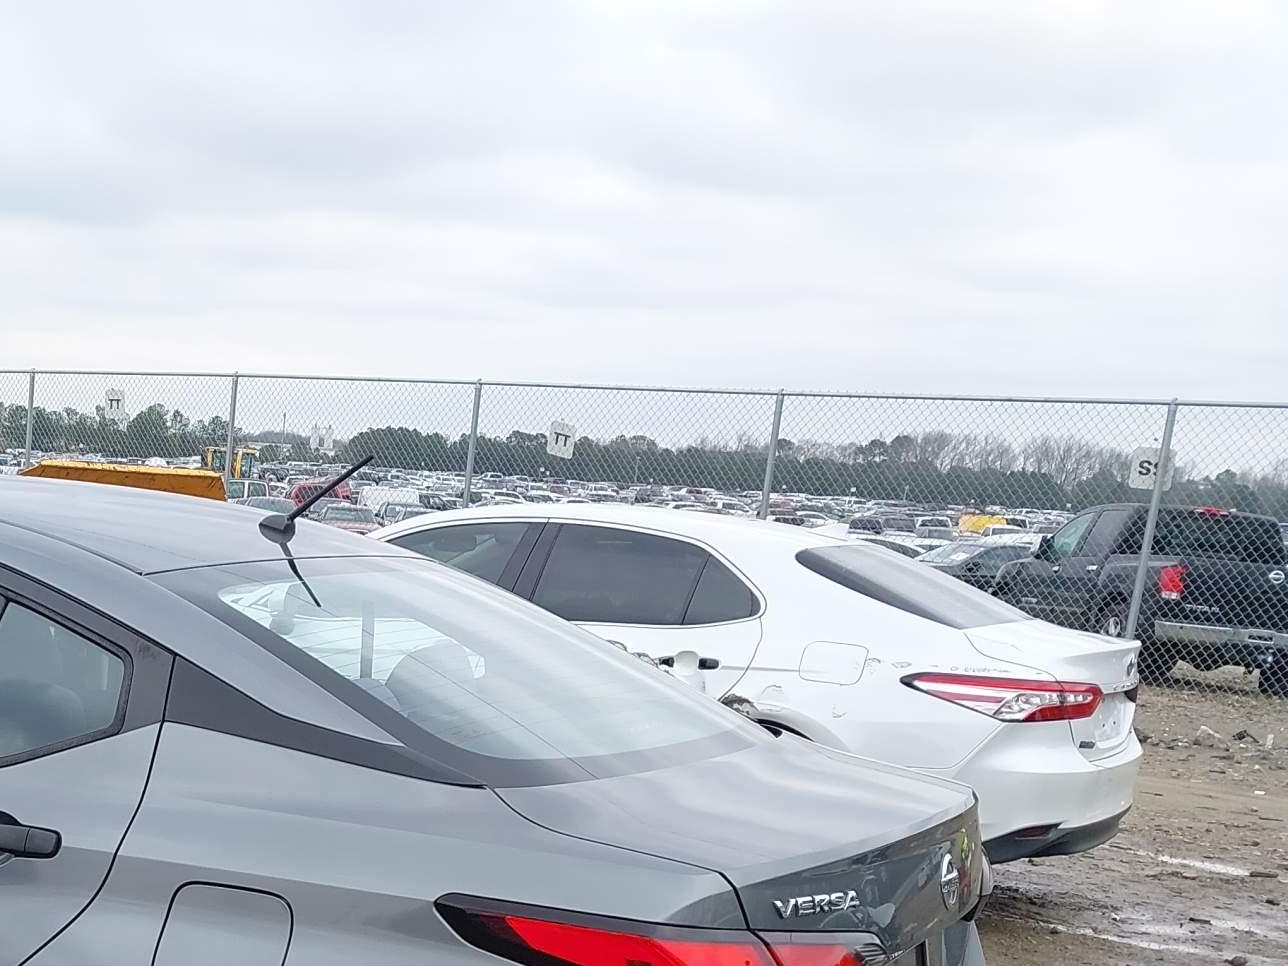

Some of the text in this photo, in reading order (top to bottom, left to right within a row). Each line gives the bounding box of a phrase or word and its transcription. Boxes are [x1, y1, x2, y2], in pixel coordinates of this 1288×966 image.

[108, 398, 122, 410] TT
[554, 431, 571, 447] TT
[773, 890, 860, 919] VERSA
